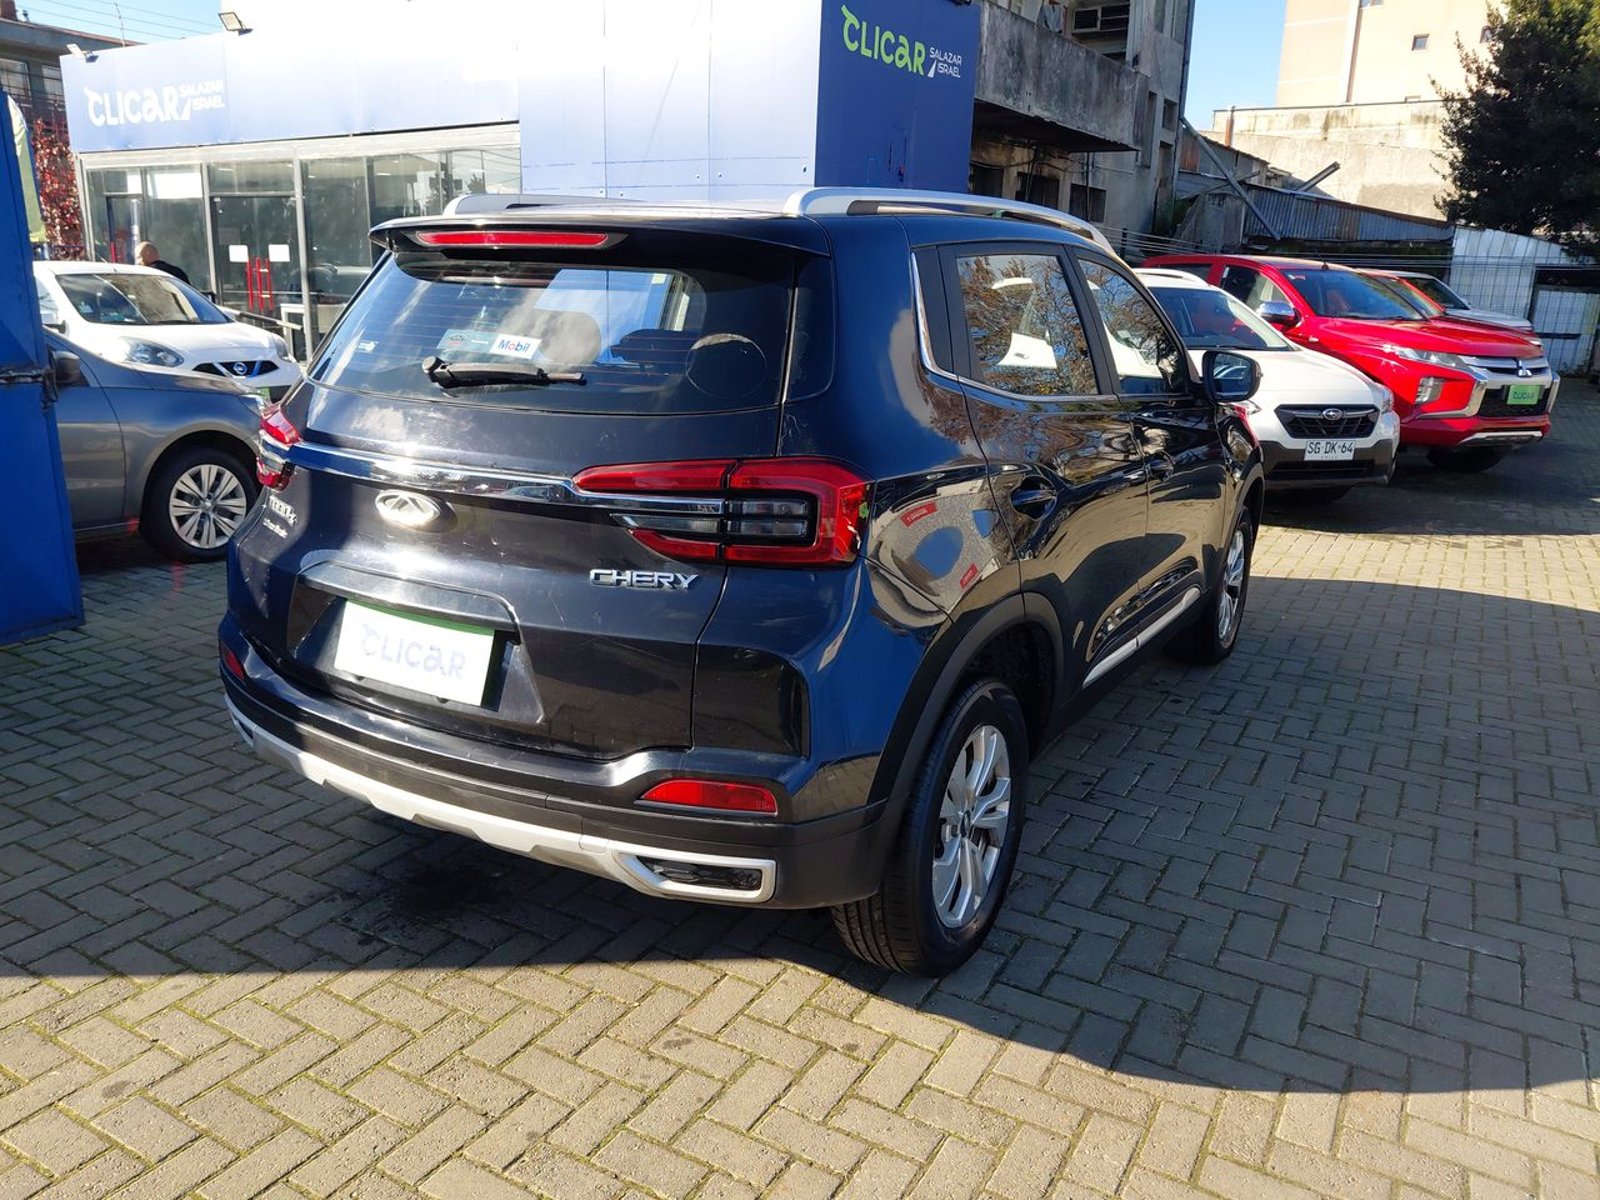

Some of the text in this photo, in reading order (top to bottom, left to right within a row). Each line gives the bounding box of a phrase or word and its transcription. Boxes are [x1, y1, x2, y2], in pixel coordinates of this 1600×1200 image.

[929, 47, 962, 65] SALAZAR
[937, 63, 961, 78] ISRAEL
[498, 339, 531, 353] Mobil
[589, 568, 699, 592] CHERY
